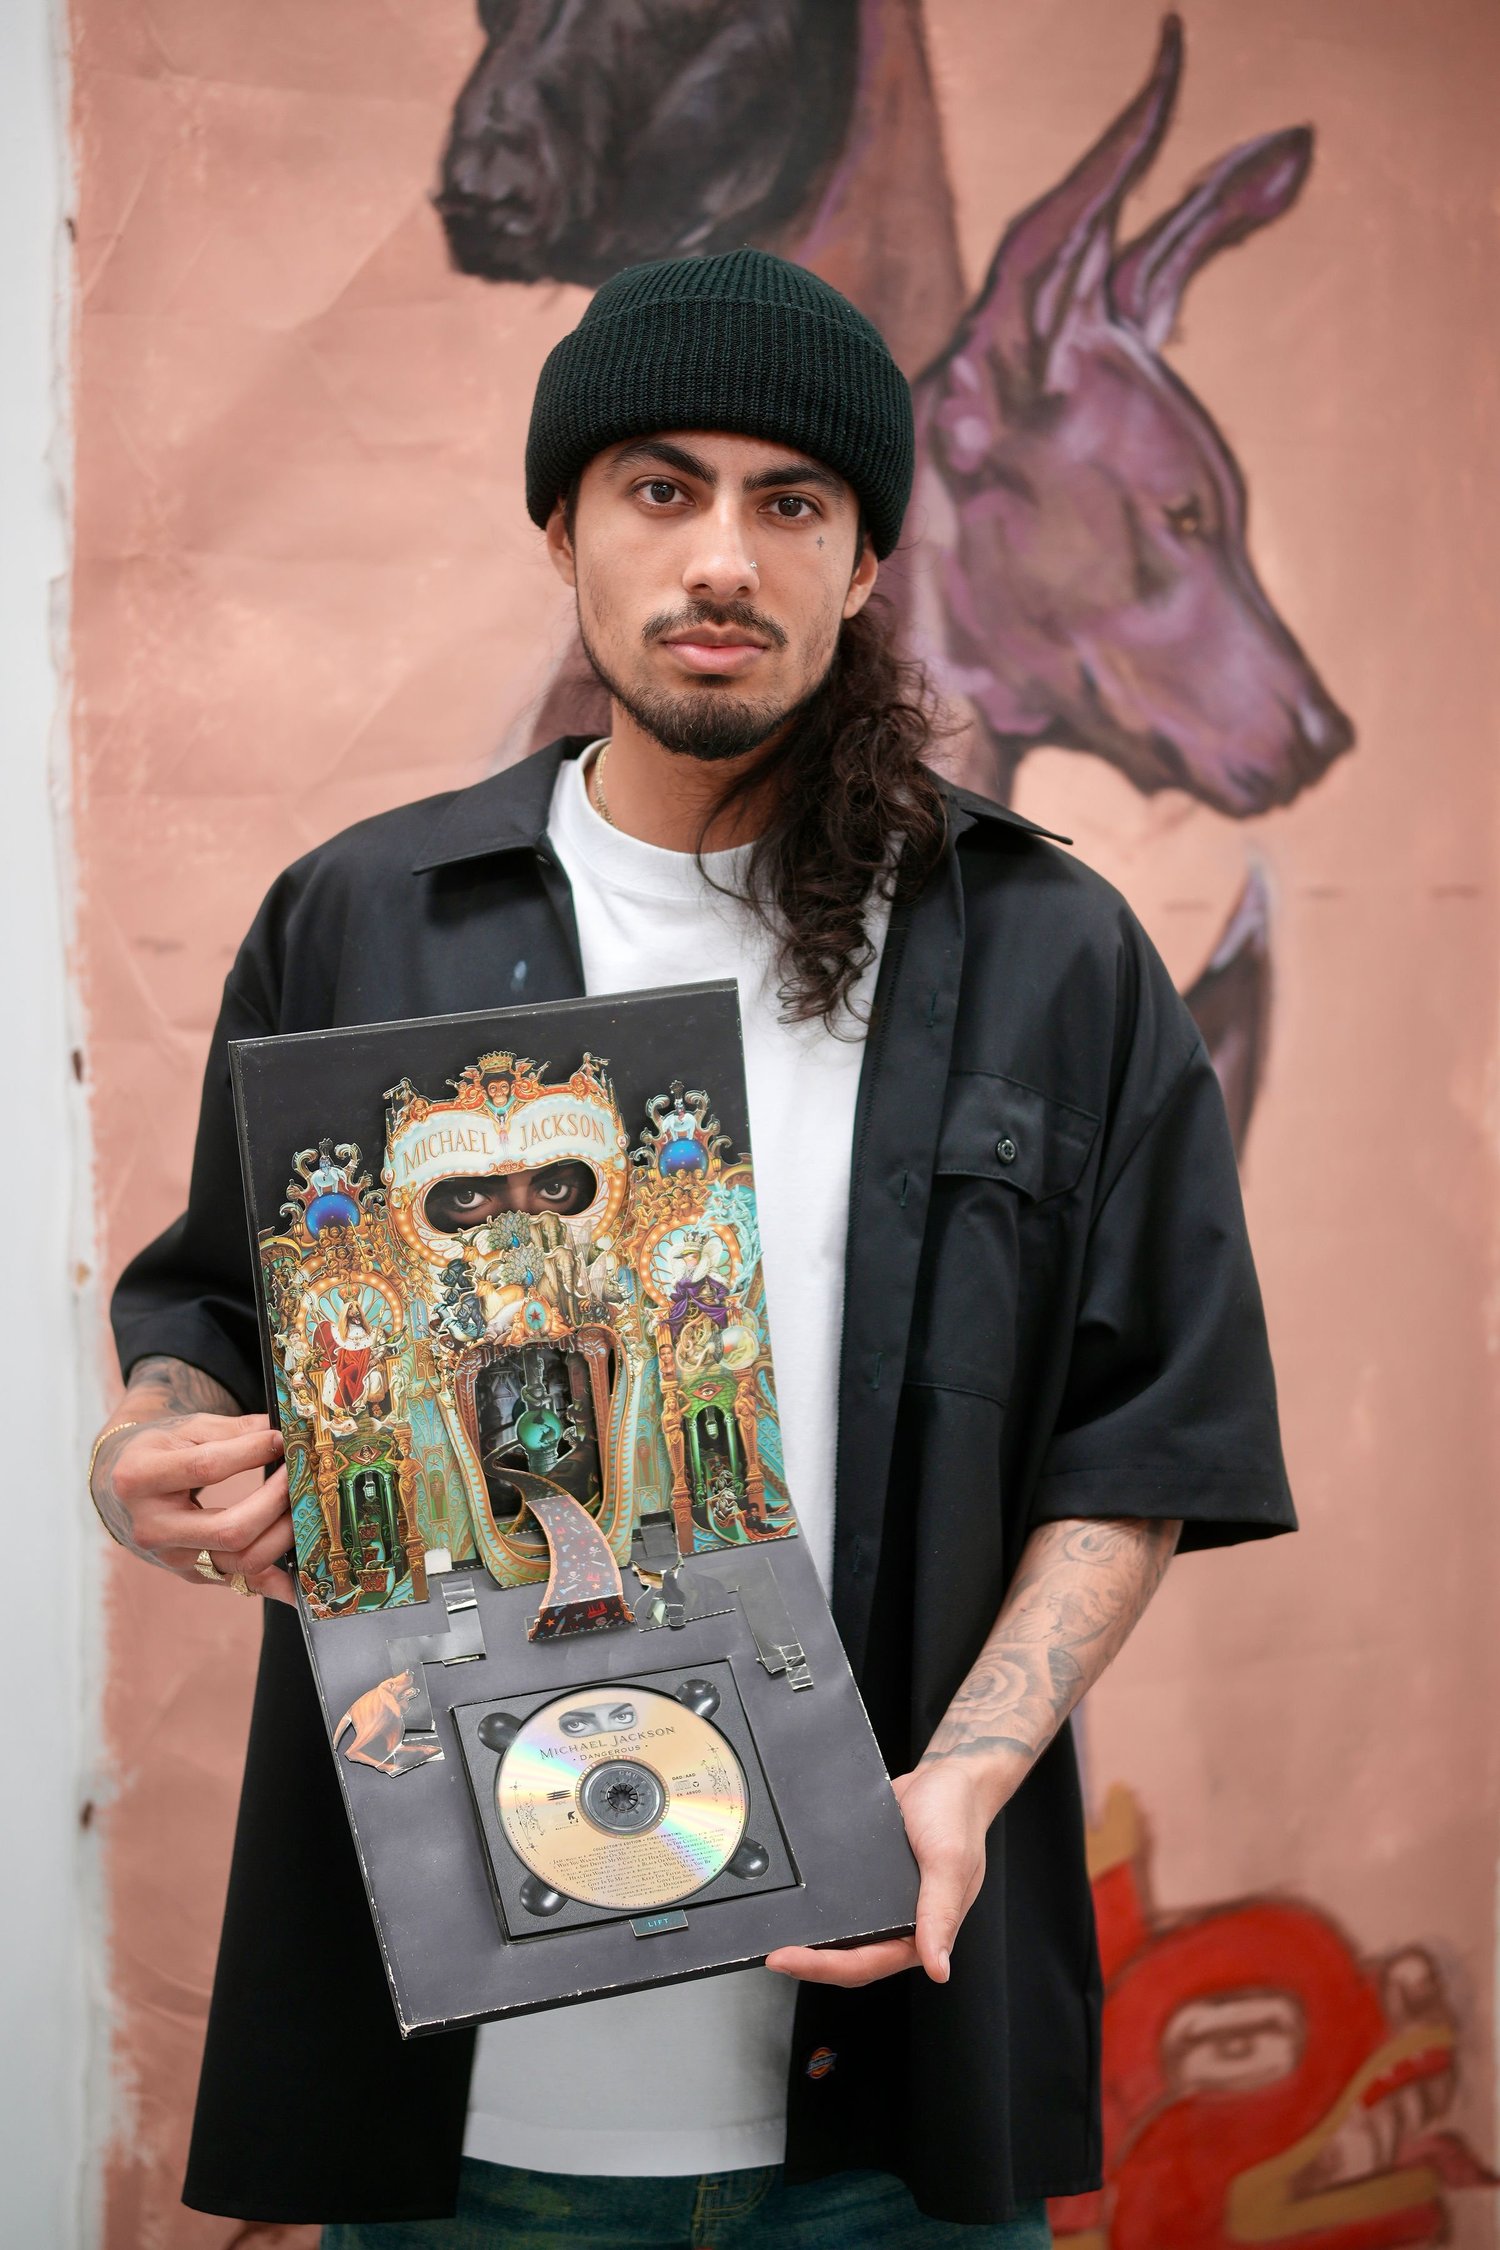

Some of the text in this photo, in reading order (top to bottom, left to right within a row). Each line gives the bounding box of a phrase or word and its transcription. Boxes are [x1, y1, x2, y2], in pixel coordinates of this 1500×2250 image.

[403, 1113, 606, 1177] MICHAEL JACKSON
[580, 1744, 641, 1760] DANGEROUS
[648, 1918, 670, 1928] LIFT
